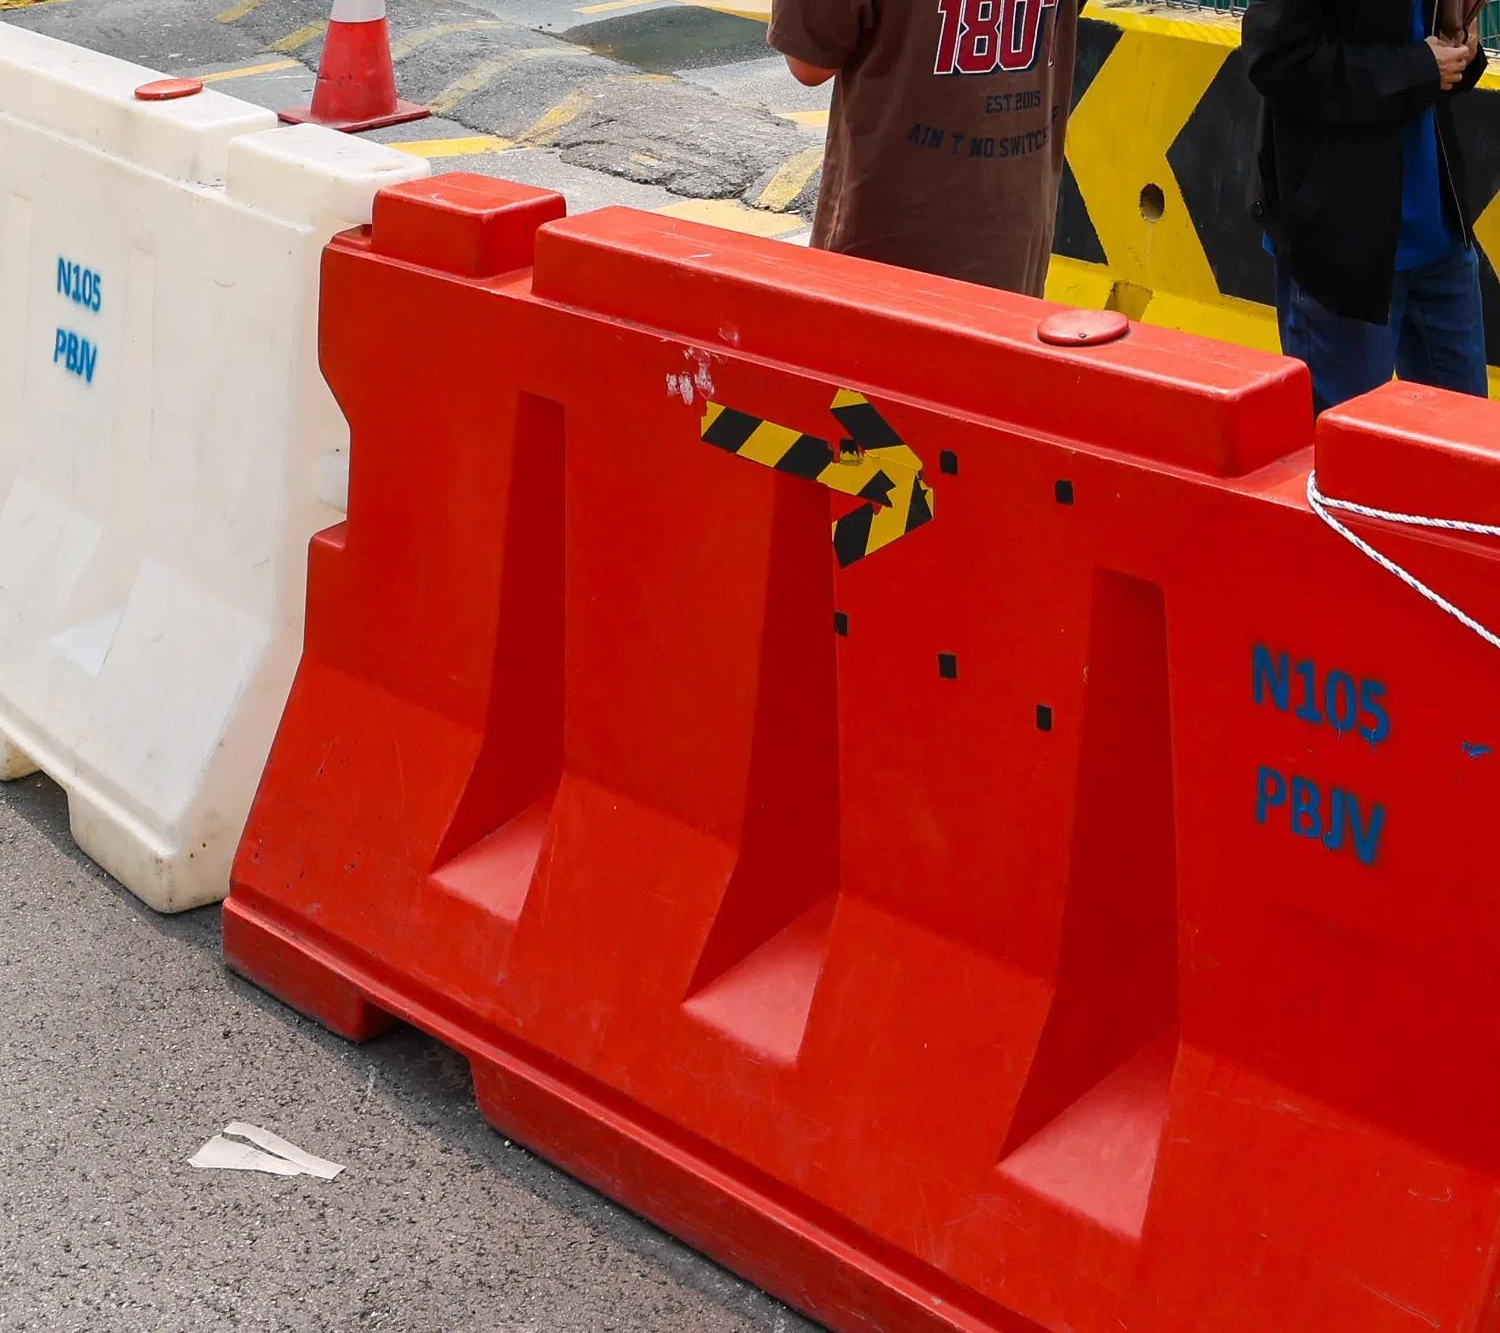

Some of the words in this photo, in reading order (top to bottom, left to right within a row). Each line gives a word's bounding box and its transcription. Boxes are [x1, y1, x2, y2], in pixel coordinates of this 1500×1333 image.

[968, 135, 996, 159] NO
[56, 256, 102, 313] N105
[53, 327, 98, 384] PBJV
[1252, 643, 1391, 746] N105
[1254, 765, 1386, 865] PBJV
